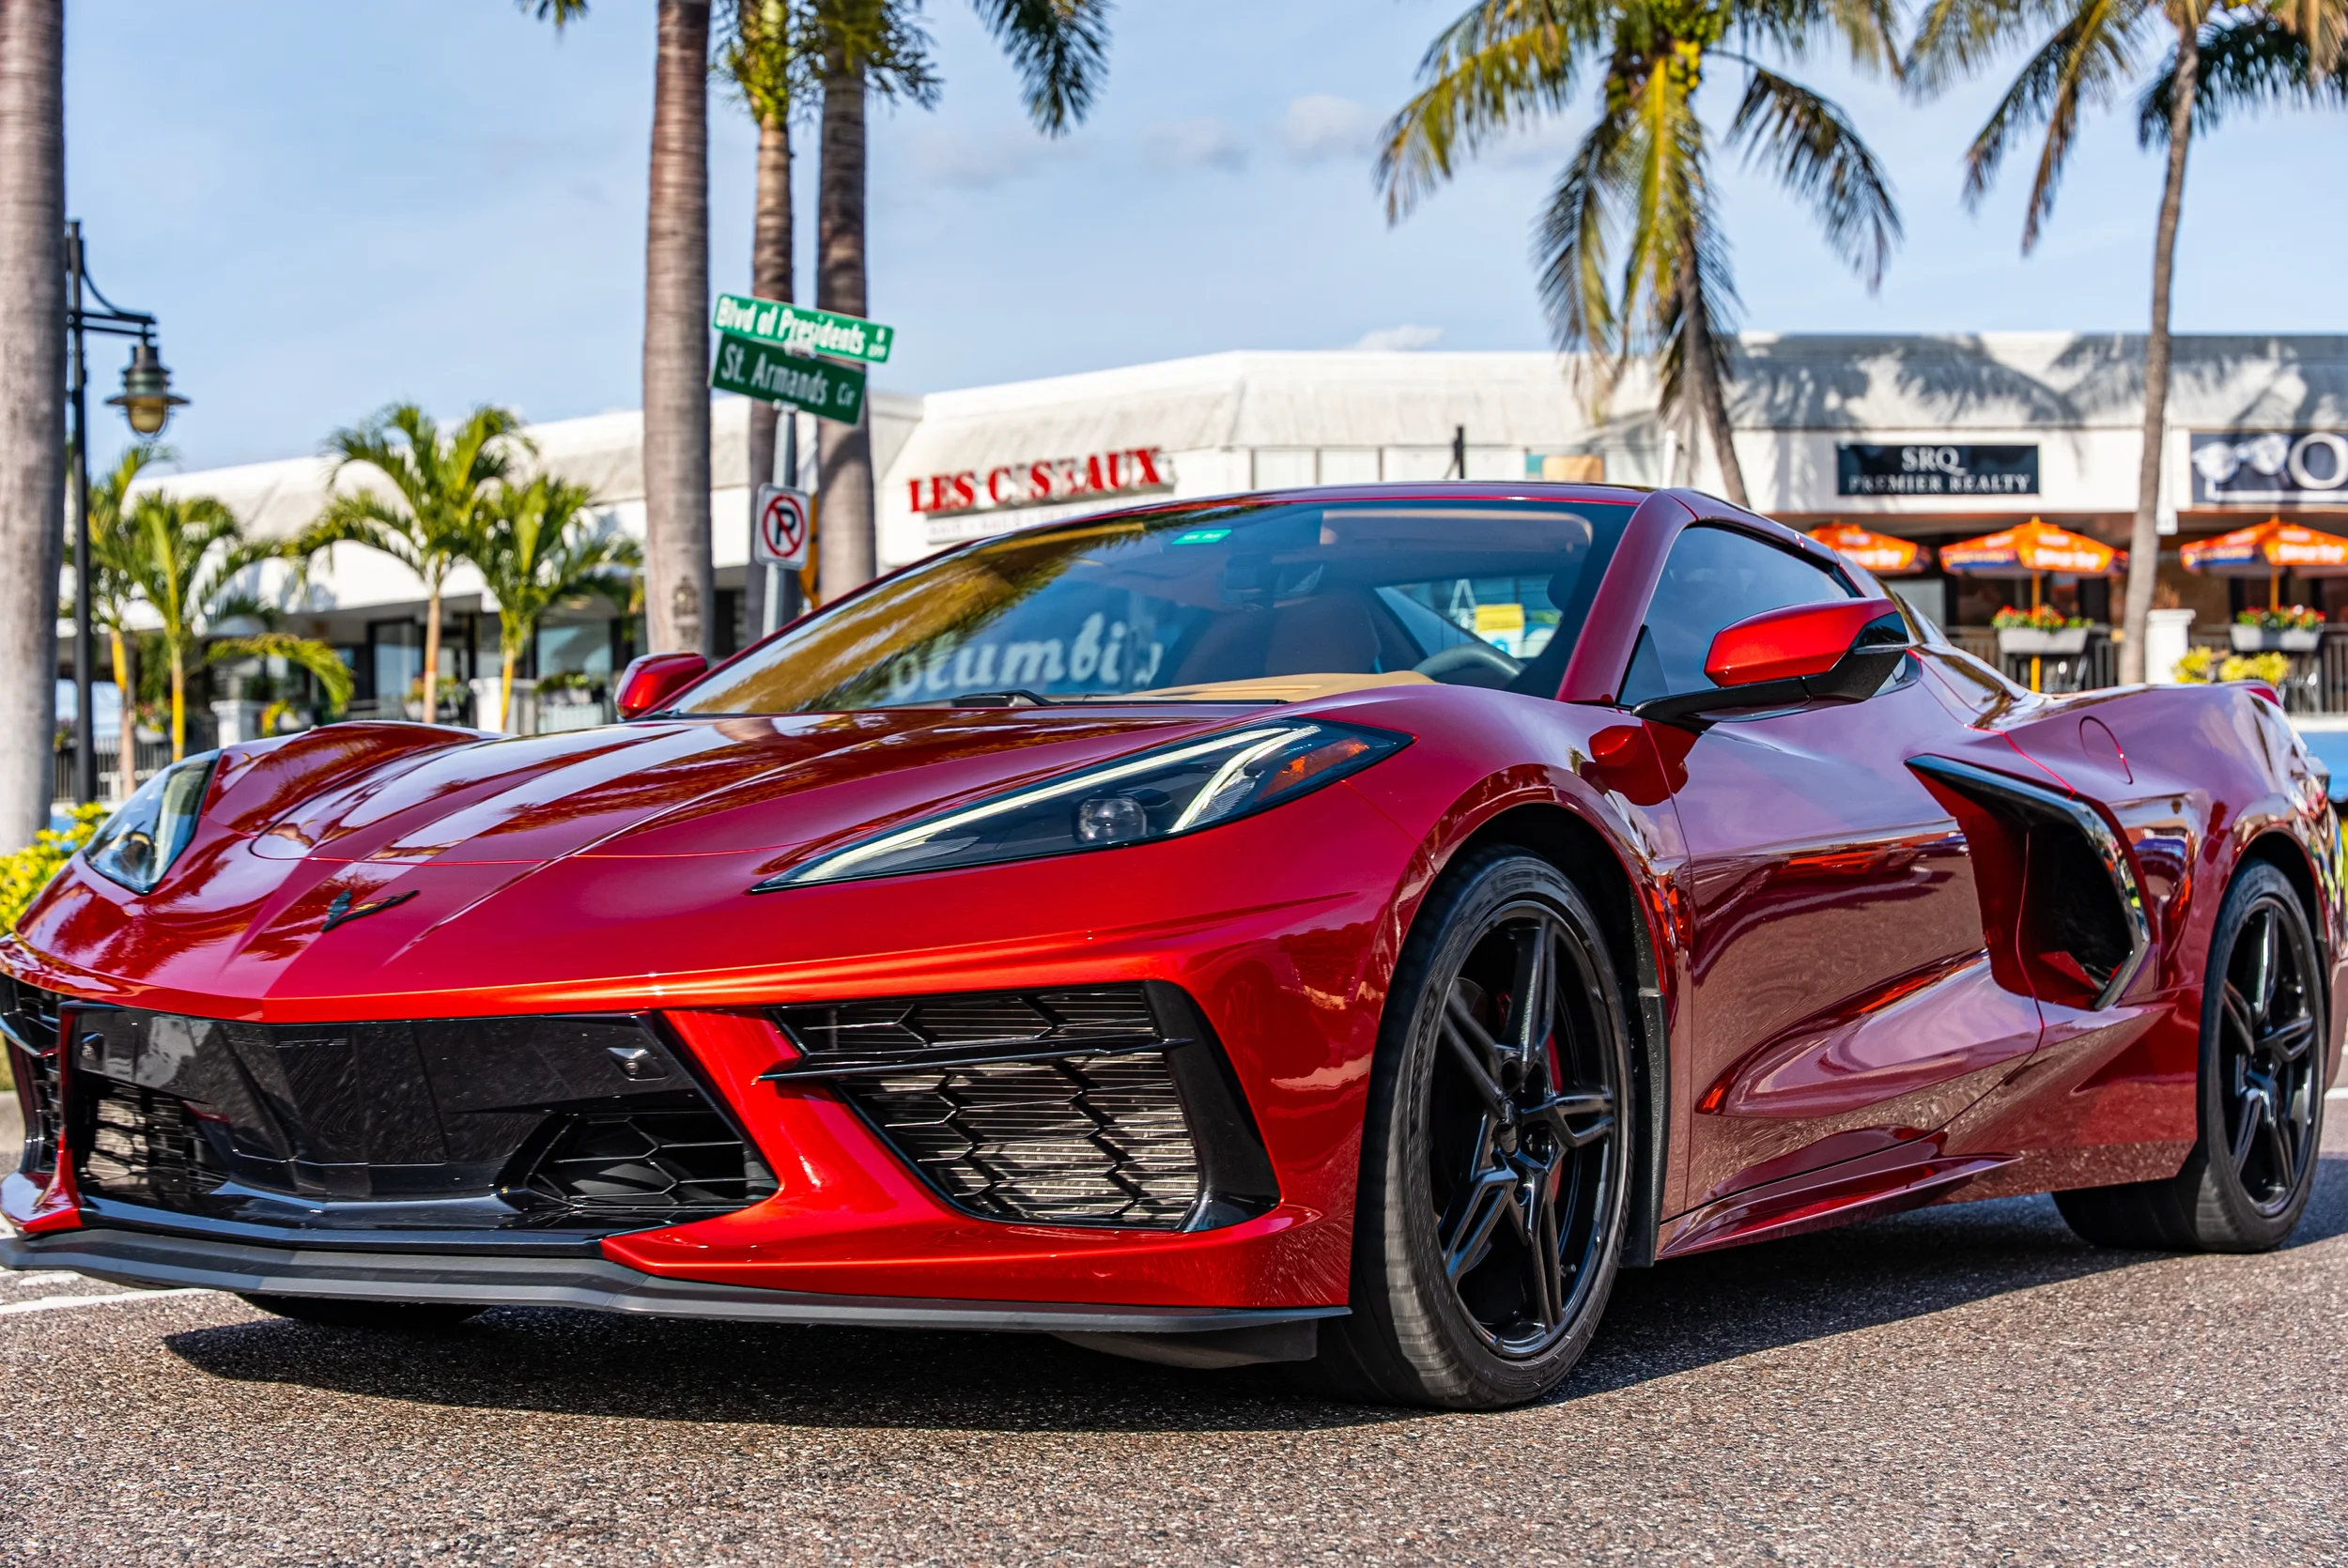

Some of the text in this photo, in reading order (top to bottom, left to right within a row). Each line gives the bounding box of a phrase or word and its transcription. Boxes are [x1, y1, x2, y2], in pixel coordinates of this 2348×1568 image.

[716, 296, 757, 332] Blvd
[757, 305, 779, 336] of
[778, 308, 866, 355] Presidents
[721, 343, 857, 407] St. Armands Cir
[1902, 446, 1969, 476] SRQ
[907, 471, 977, 513] LES
[1848, 473, 2031, 494] PREMIER REALTY
